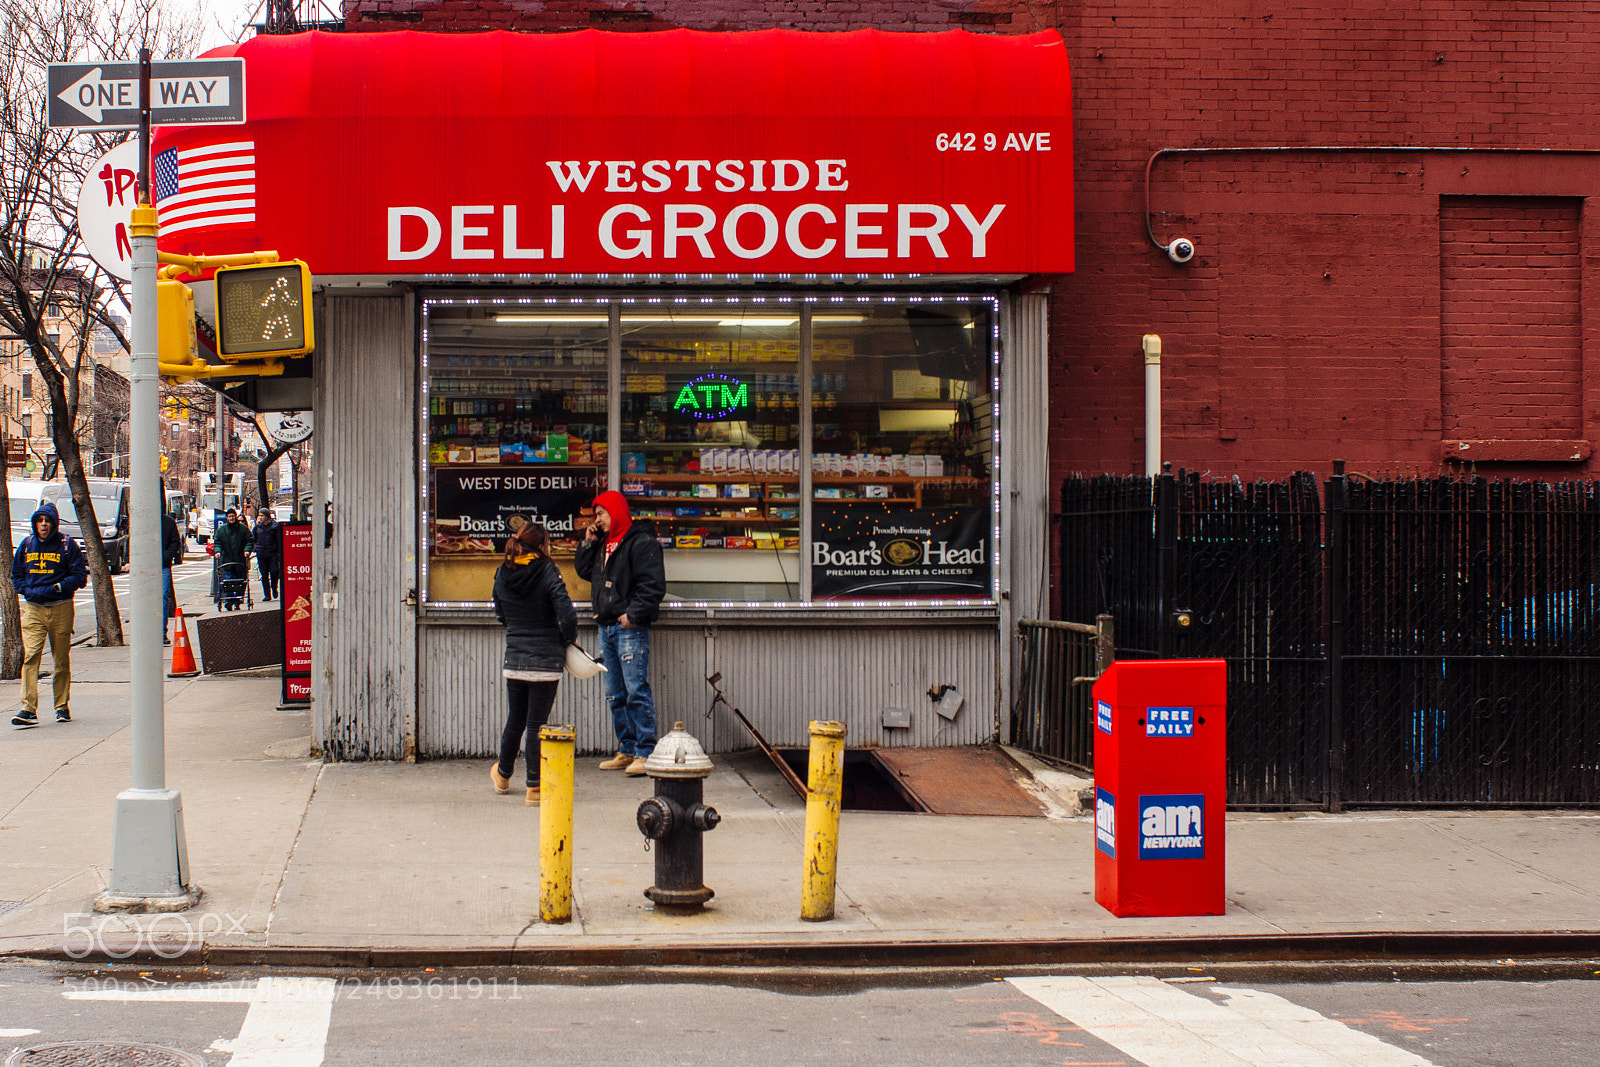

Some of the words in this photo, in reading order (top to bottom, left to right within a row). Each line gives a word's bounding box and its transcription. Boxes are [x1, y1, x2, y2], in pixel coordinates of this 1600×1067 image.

[78, 83, 132, 107] ONE
[160, 80, 217, 105] WAY
[936, 132, 977, 152] 642
[983, 132, 997, 151] 9
[1002, 131, 1052, 152] AVE
[545, 158, 849, 194] WESTSIDE
[386, 204, 566, 260] DELI
[597, 202, 1006, 260] GROCERY
[673, 383, 748, 409] ATM
[459, 477, 501, 490] WEST
[504, 477, 537, 490] SIDE
[540, 476, 572, 490] DELI
[459, 514, 505, 532] Boar's
[531, 513, 574, 531] Head
[872, 525, 898, 535] Proudly
[899, 526, 932, 536] Featuring
[812, 540, 882, 566] Boar's
[921, 538, 986, 565] Head
[287, 565, 311, 574] $5.00
[1098, 703, 1112, 719] FREE
[1150, 710, 1190, 721] FREE
[1098, 715, 1112, 732] DAILY
[1146, 723, 1194, 734] DAILY
[1141, 805, 1202, 836] am
[1143, 836, 1203, 849] NEWYORK
